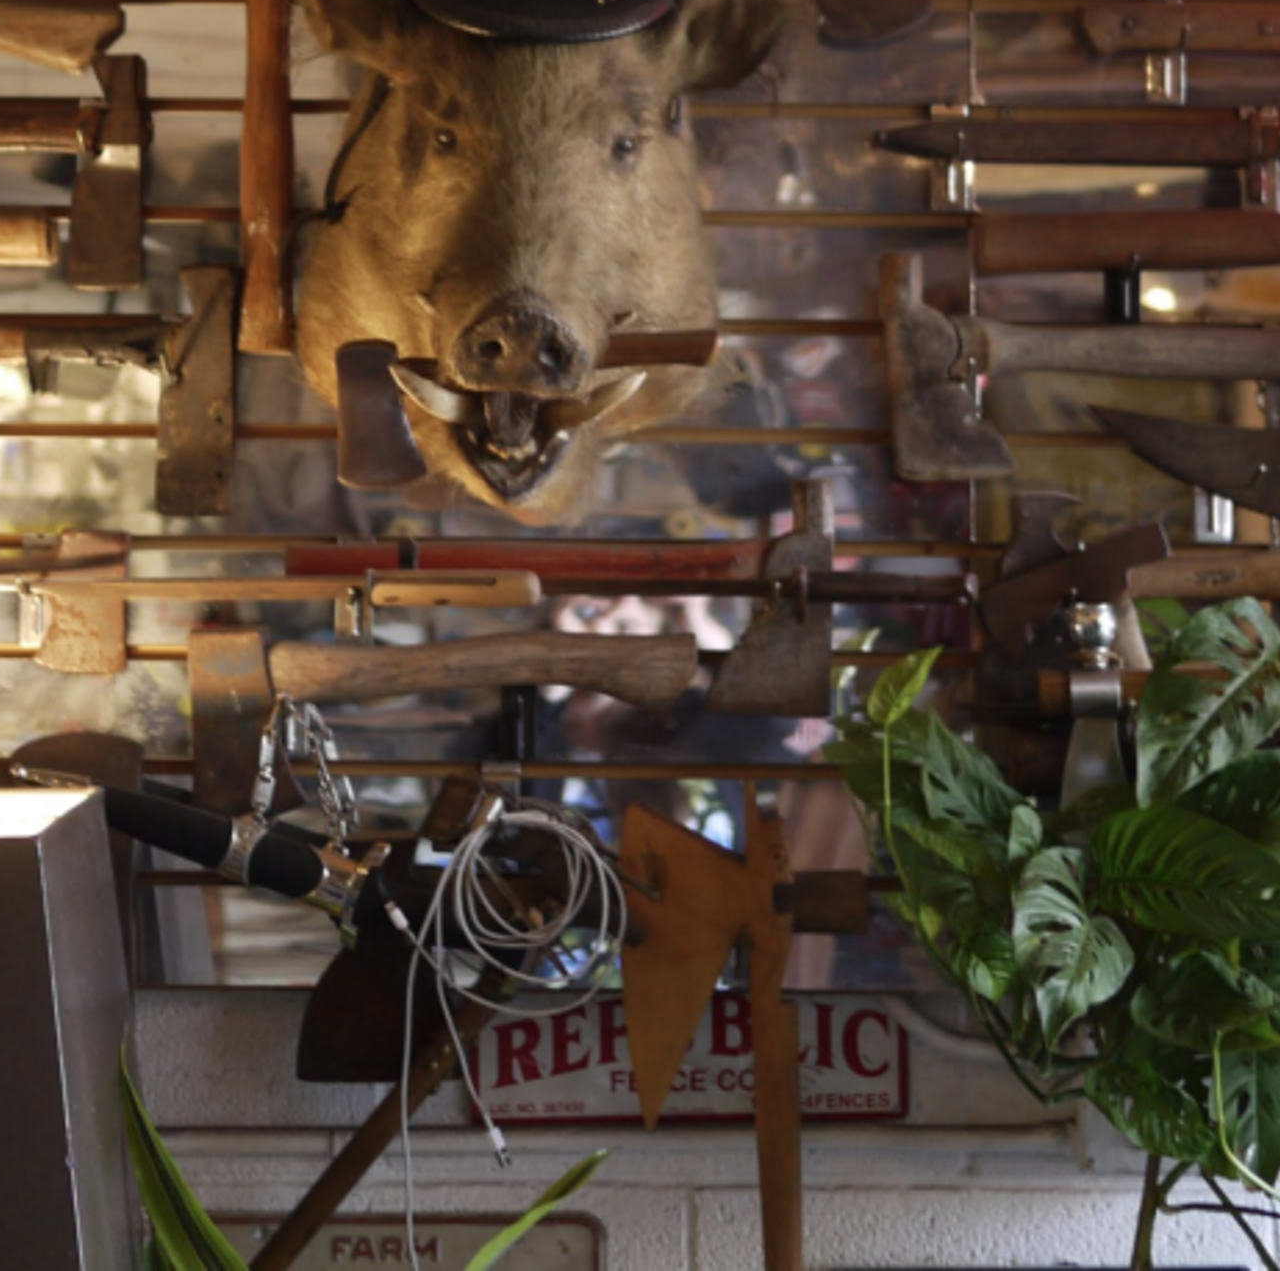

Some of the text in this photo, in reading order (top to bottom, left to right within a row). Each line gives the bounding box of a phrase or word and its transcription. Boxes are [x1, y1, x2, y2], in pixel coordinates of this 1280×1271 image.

[492, 992, 890, 1087] REPBIC
[610, 1069, 708, 1093] FECE
[330, 1236, 439, 1262] FARM
